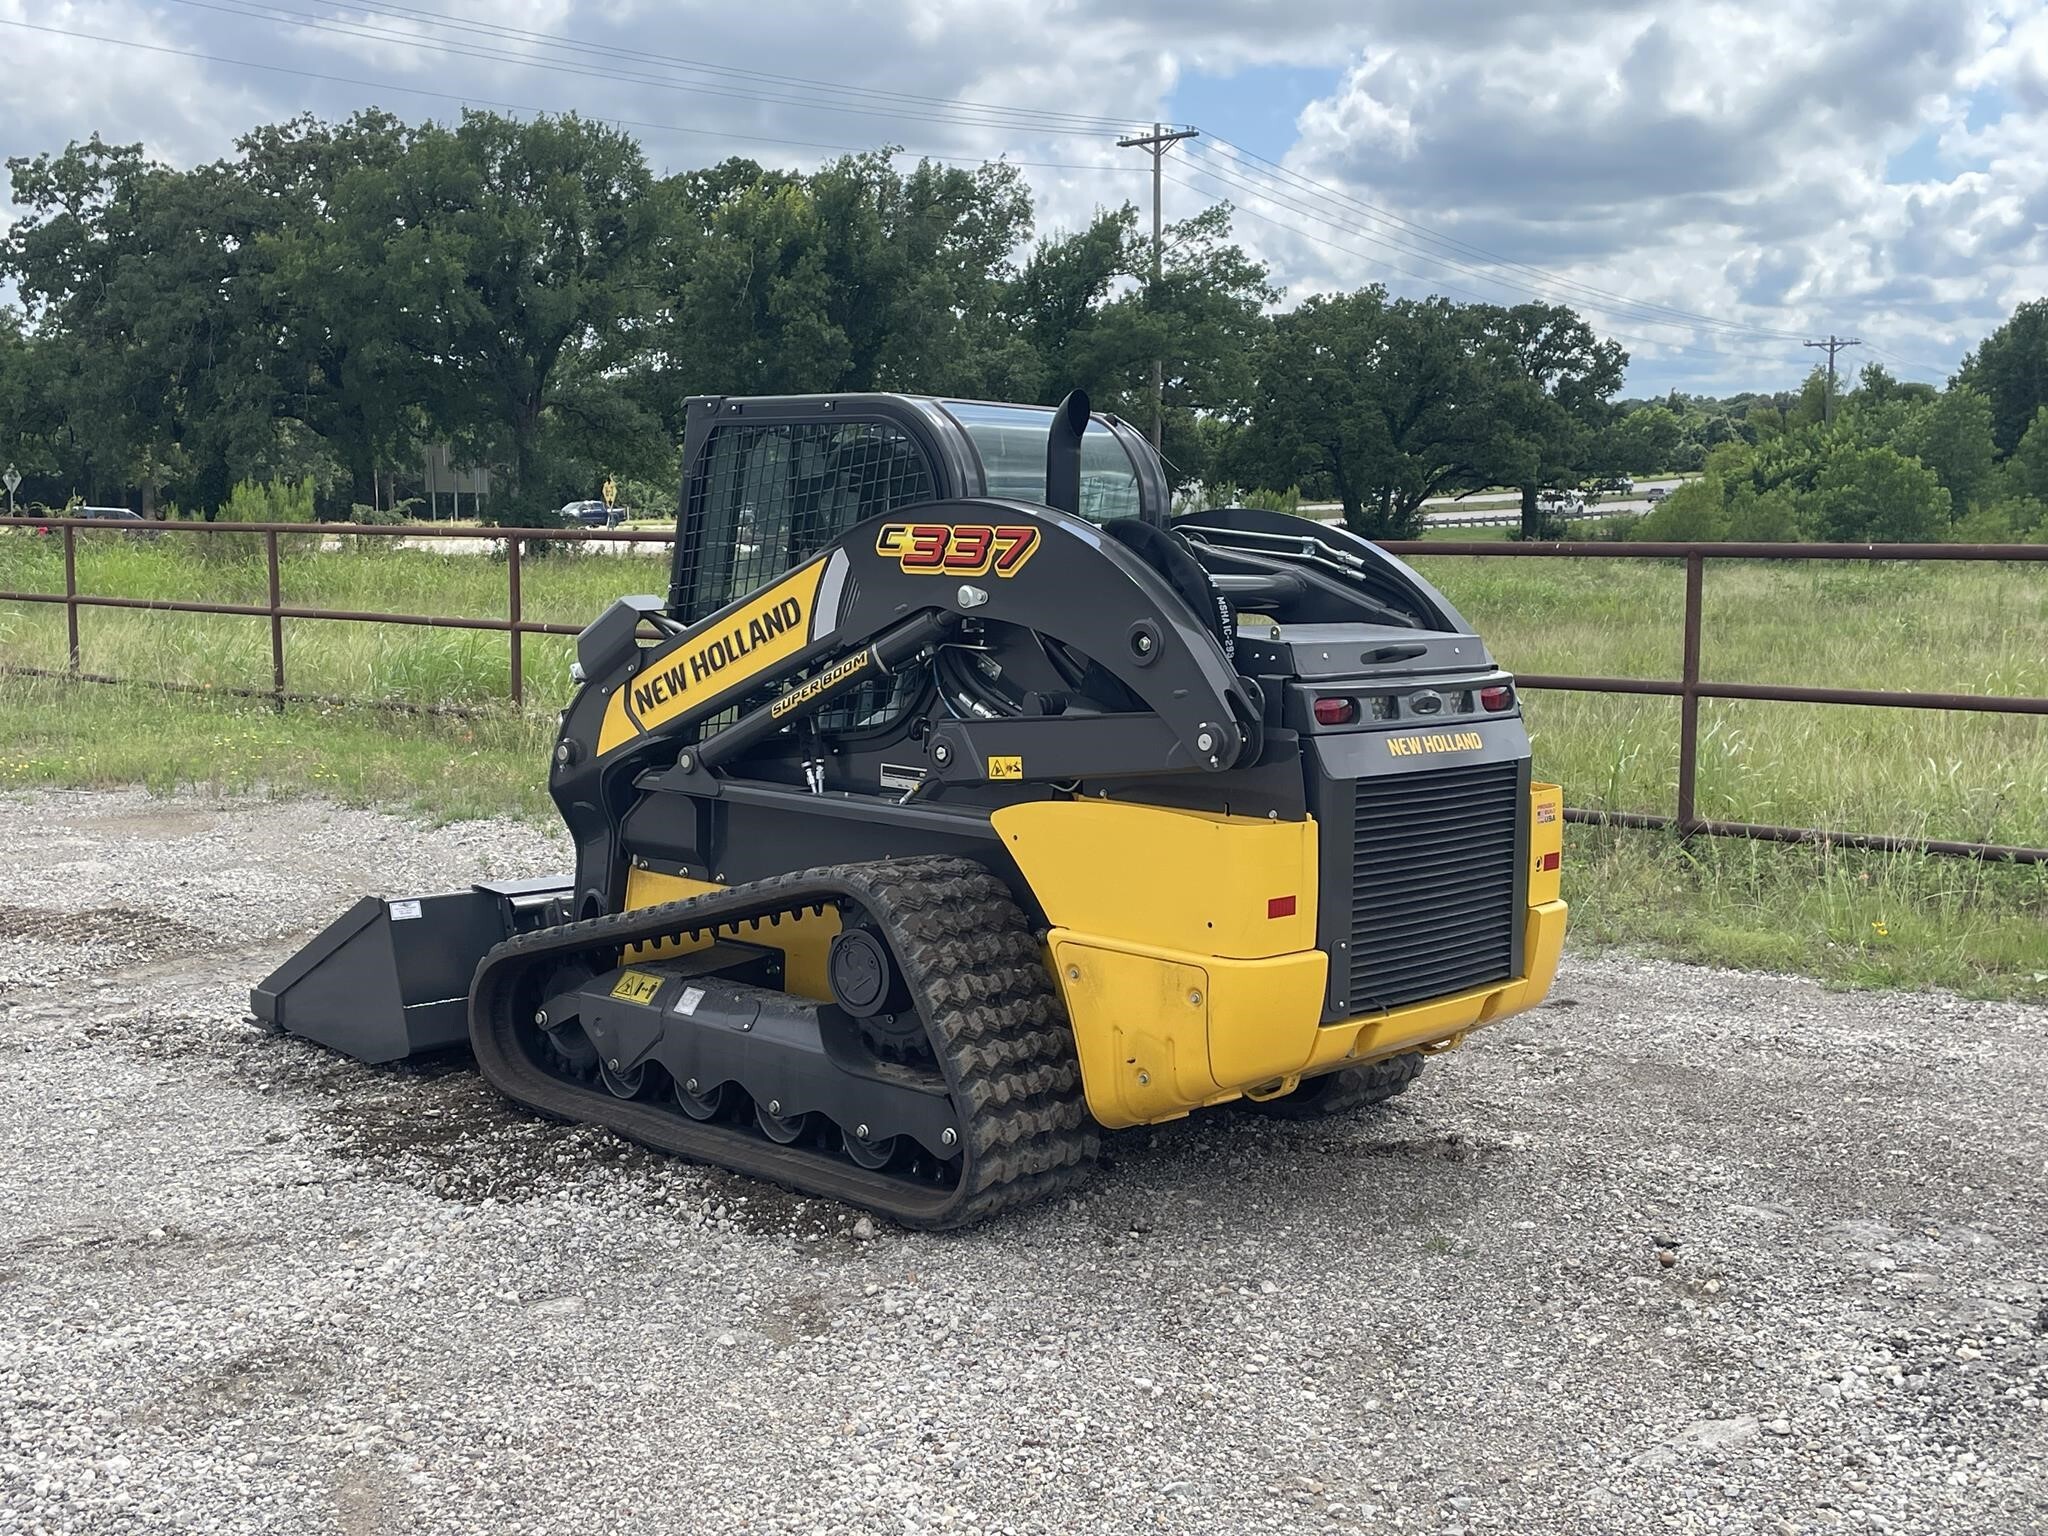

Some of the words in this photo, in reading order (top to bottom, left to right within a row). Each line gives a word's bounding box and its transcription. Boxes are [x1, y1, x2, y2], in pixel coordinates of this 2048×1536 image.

[877, 523, 1041, 577] C337
[1216, 596, 1231, 625] MSHA
[634, 662, 688, 715] NEW
[690, 597, 801, 683] HOLLAND
[772, 679, 822, 717] SUPER
[822, 651, 868, 688] BOOM
[1387, 736, 1423, 756] NEW
[1422, 732, 1483, 753] HOLLAND
